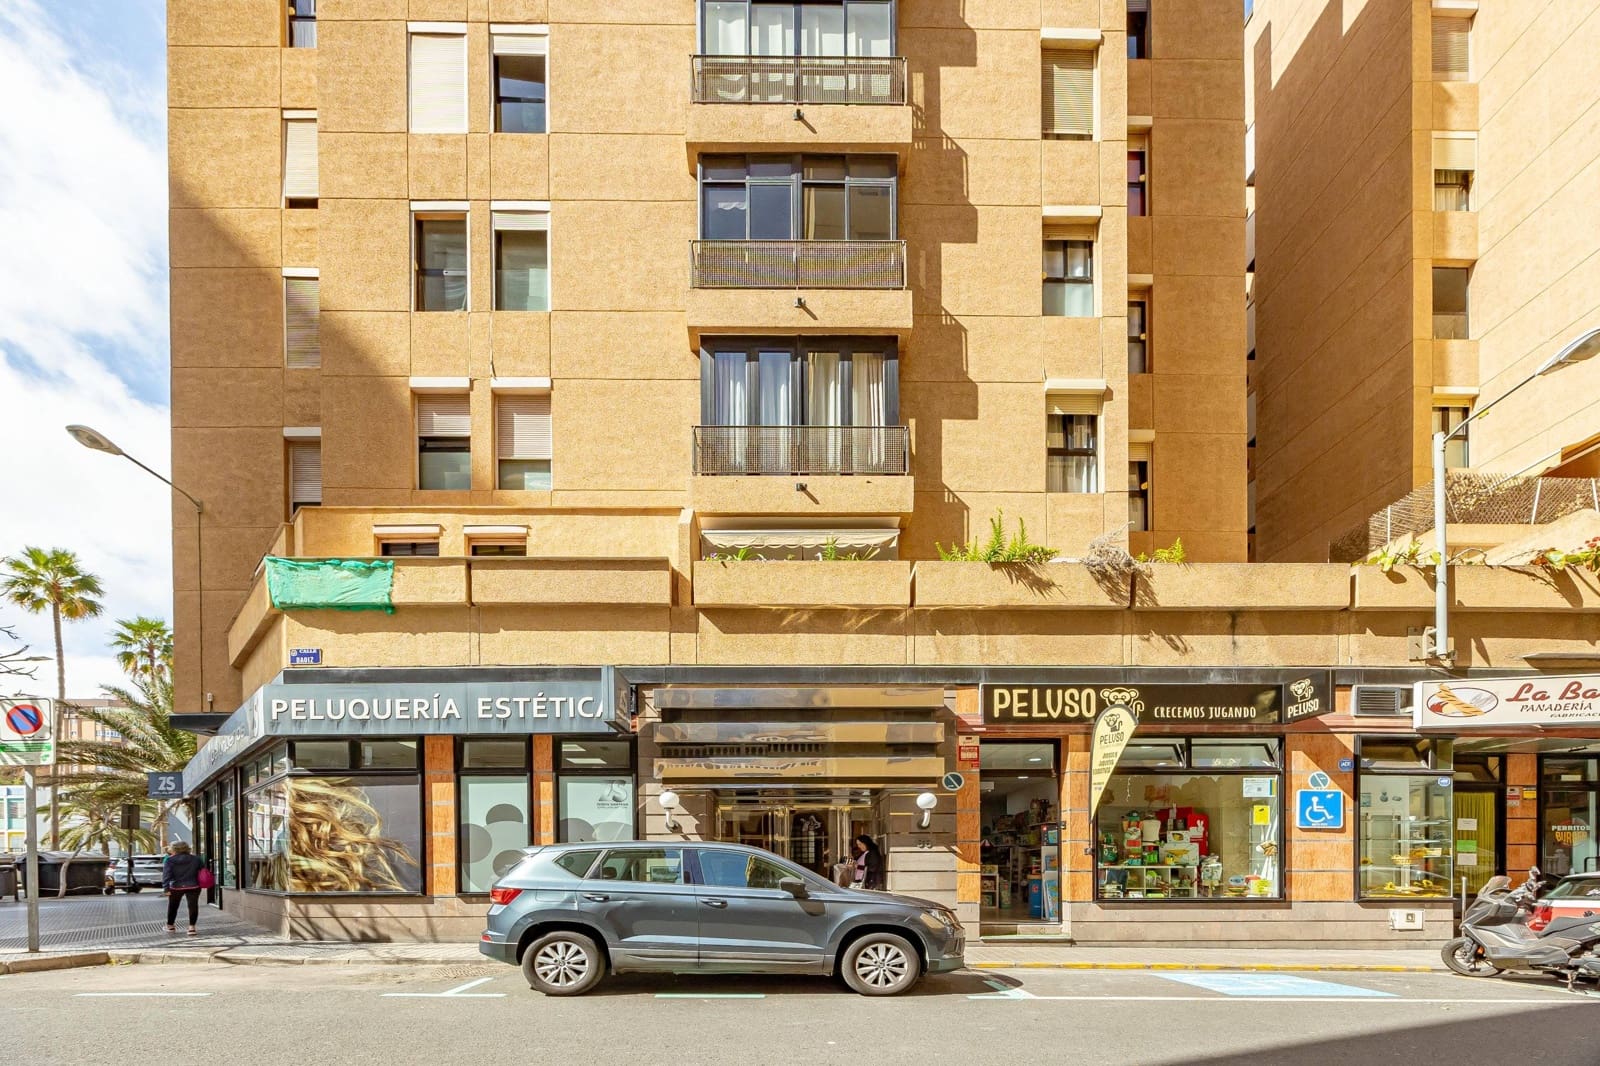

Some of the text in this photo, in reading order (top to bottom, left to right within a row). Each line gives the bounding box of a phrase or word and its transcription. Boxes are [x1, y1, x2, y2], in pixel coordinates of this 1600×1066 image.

[1505, 682, 1550, 702] La
[271, 693, 462, 721] PELUQUERÍA
[1154, 706, 1256, 720] CRECEMOS JUGANDO
[1520, 700, 1593, 713] PANADERÍA
